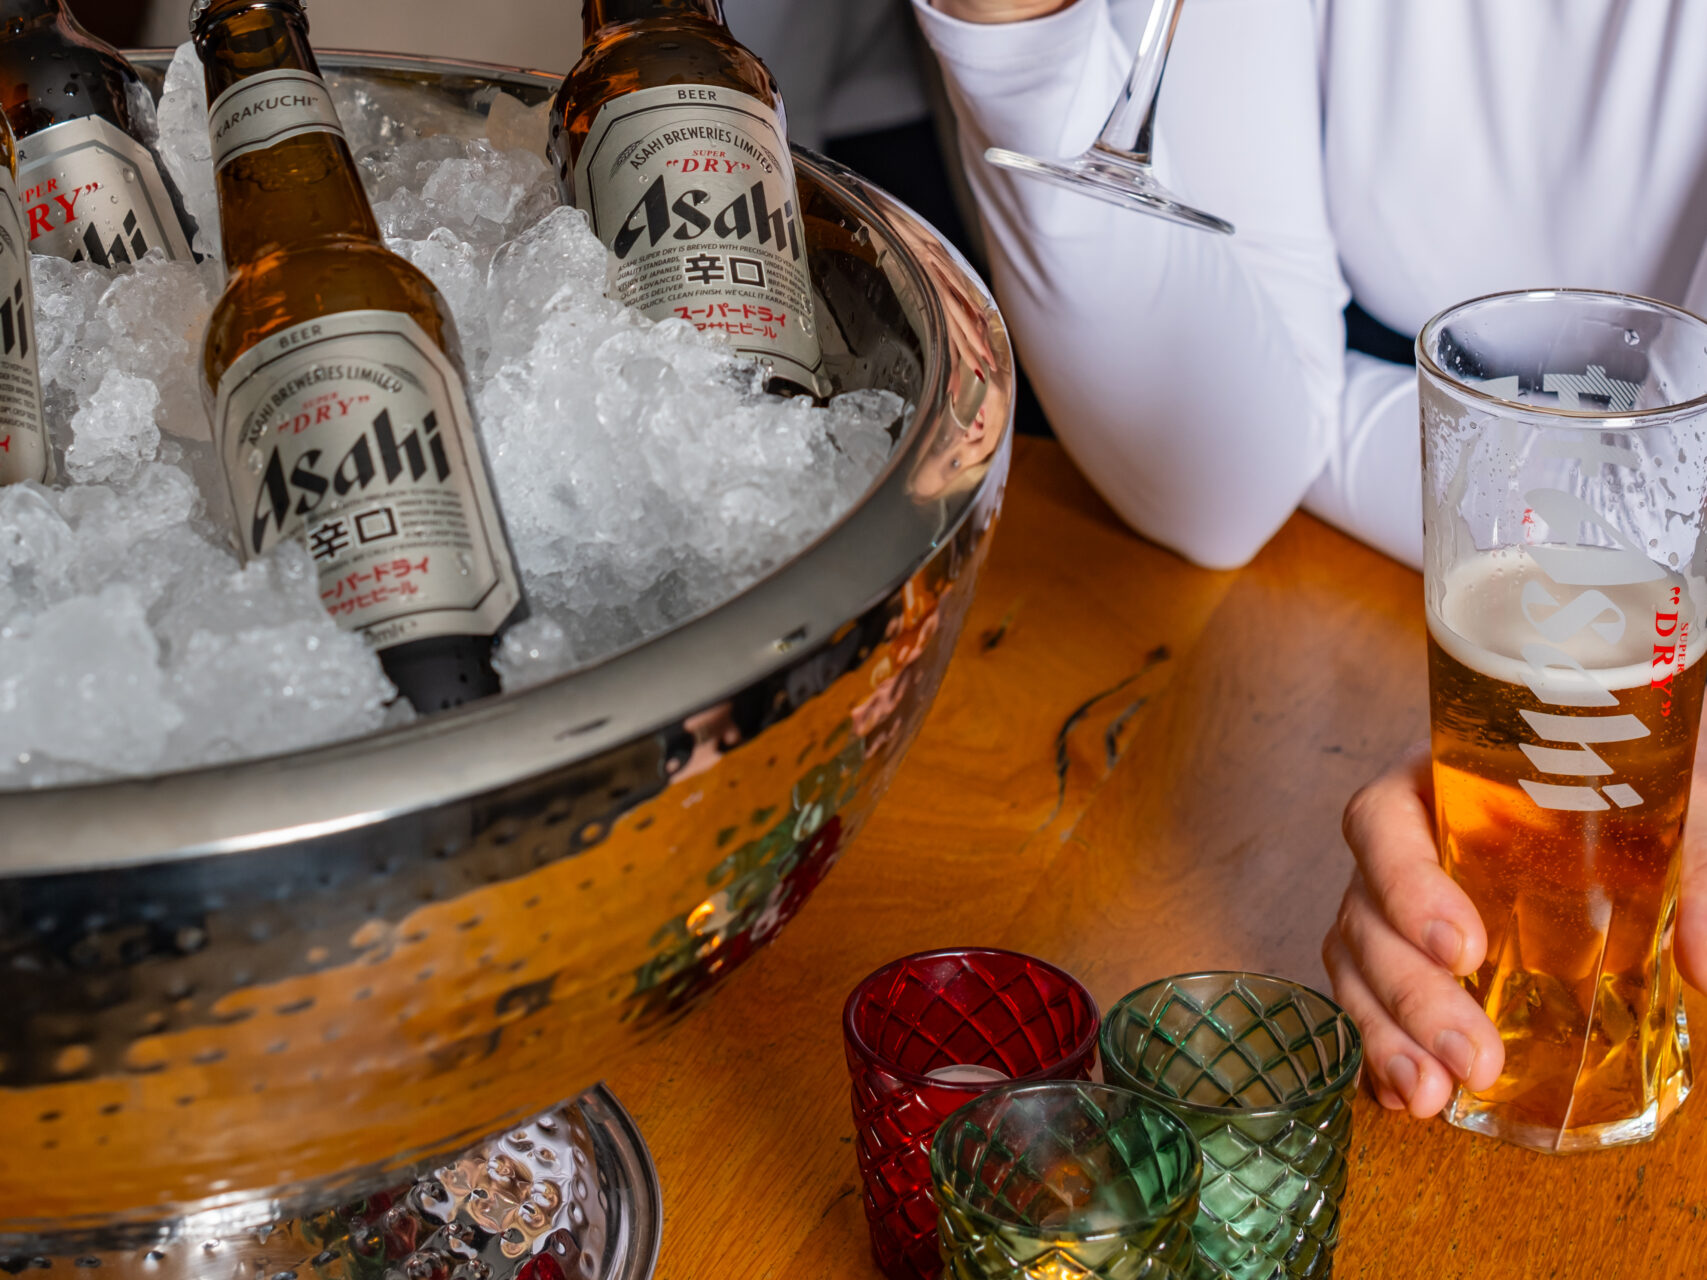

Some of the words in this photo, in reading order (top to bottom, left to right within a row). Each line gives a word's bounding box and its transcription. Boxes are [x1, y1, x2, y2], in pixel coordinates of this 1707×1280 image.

[678, 90, 717, 101] BEER
[630, 137, 664, 170] ASAHI
[662, 126, 732, 146] BREWERIES
[734, 135, 772, 174] LIMITED
[692, 149, 726, 158] SUPER
[614, 174, 800, 261] Asahi
[686, 243, 717, 251] BREWED
[639, 275, 682, 291] ADVANCED
[685, 253, 766, 288] 辛口
[667, 289, 693, 300] CLEAN
[673, 302, 786, 327] スーパードライ
[279, 324, 322, 349] BEER
[252, 408, 451, 554] Asahi
[310, 507, 399, 561] 辛口
[321, 556, 430, 600] ーパードライ
[1518, 488, 1668, 811] Asahi
